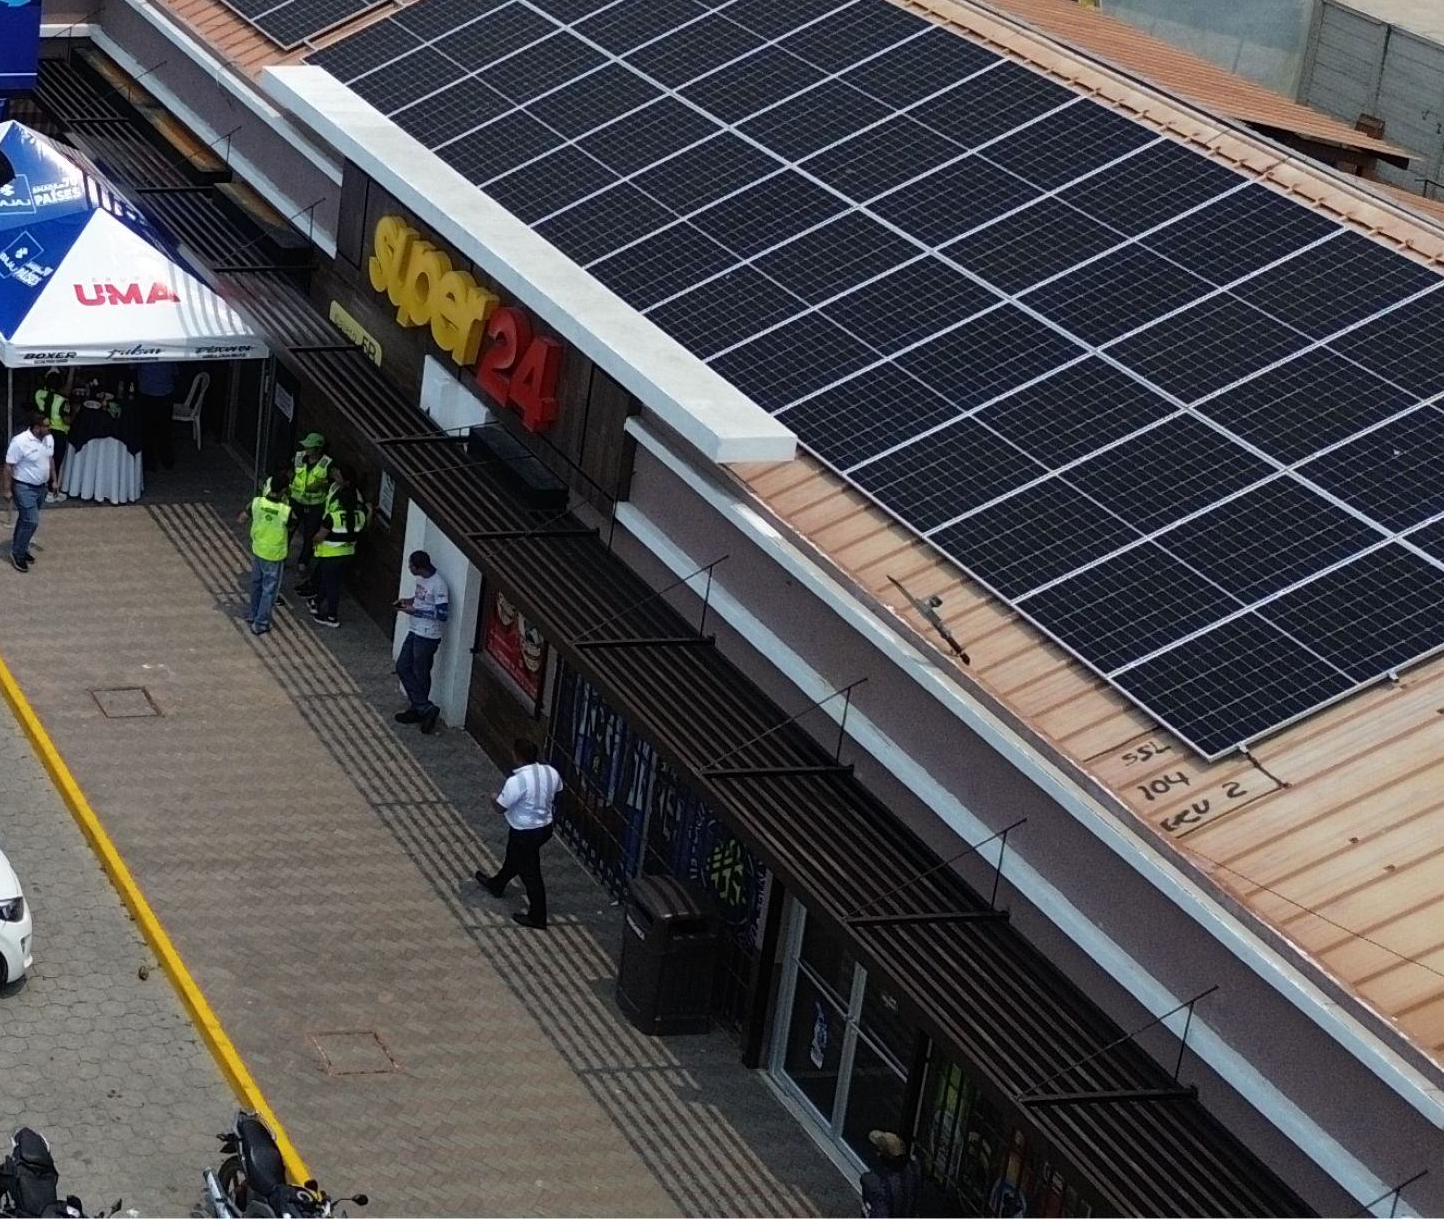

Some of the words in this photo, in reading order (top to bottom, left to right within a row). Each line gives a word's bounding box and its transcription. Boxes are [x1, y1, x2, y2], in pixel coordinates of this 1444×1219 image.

[33, 187, 83, 207] PAÍSES
[72, 281, 182, 307] UMA
[23, 351, 77, 361] BOXER
[1136, 770, 1191, 801] 104
[1221, 781, 1248, 799] 2
